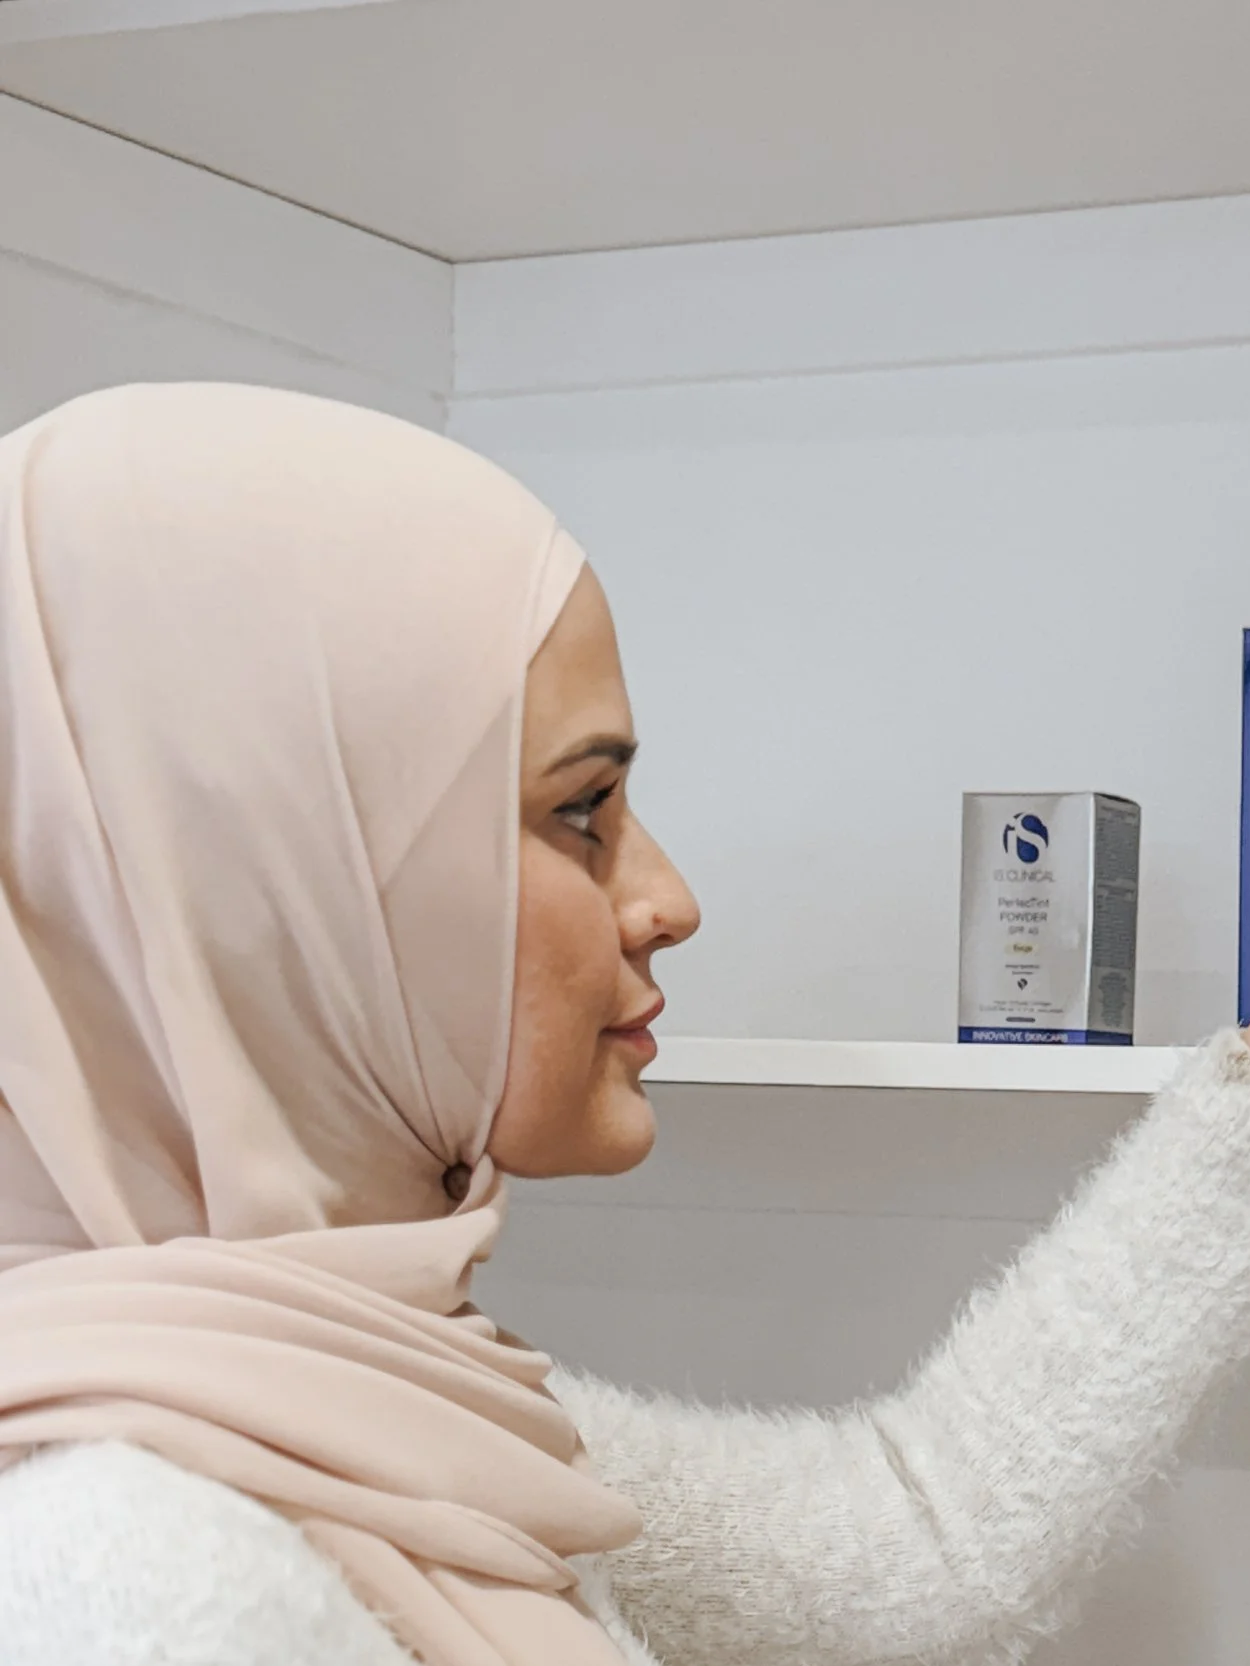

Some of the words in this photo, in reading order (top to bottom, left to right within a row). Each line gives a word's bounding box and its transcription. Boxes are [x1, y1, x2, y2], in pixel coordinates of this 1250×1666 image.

[1006, 869, 1055, 882] CLINICAL
[1000, 911, 1048, 923] POWDER
[972, 1030, 1022, 1042] INNOVATIVE
